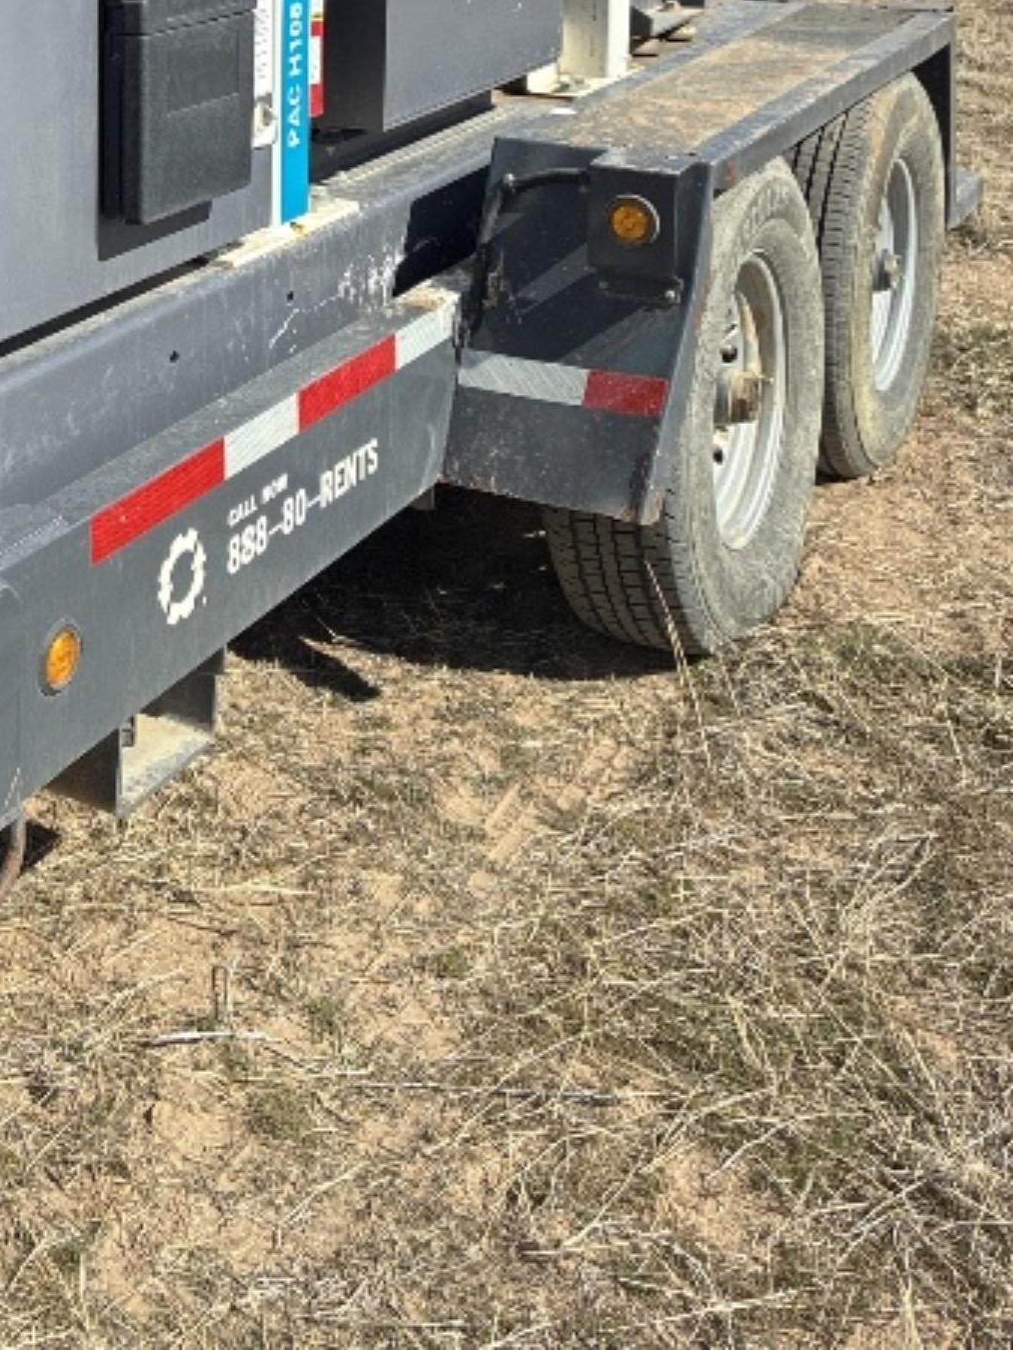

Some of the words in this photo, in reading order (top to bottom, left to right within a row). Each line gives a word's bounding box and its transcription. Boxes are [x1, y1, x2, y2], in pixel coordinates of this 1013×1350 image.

[288, 83, 301, 148] PAC
[227, 437, 379, 575] 888-80-RENTS
[227, 494, 258, 529] CALL
